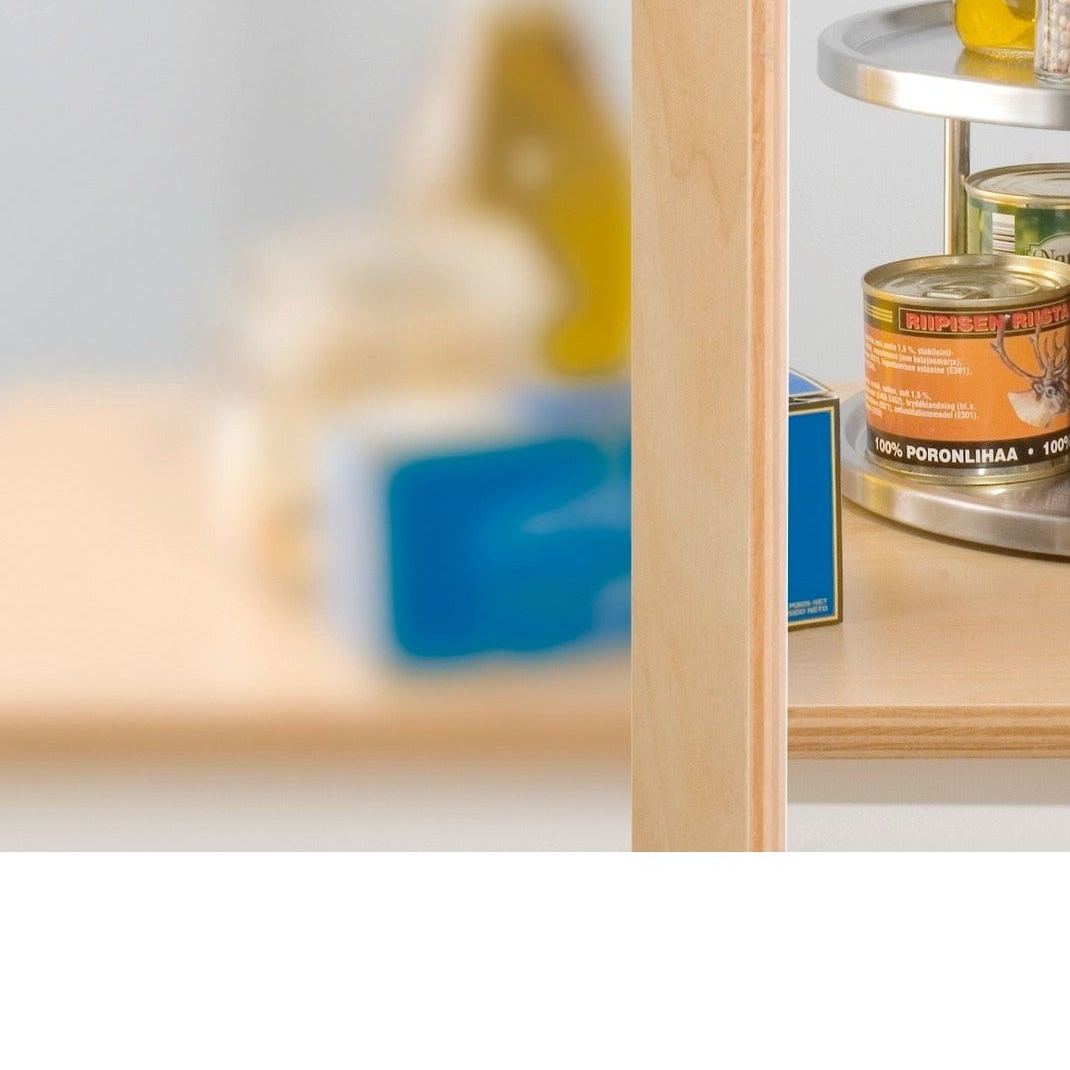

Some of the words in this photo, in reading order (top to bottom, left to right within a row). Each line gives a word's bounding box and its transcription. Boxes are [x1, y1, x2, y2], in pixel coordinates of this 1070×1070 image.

[905, 312, 1005, 332] RIIPISEN
[875, 436, 903, 457] 100%
[906, 445, 1018, 463] PORONLIHAA
